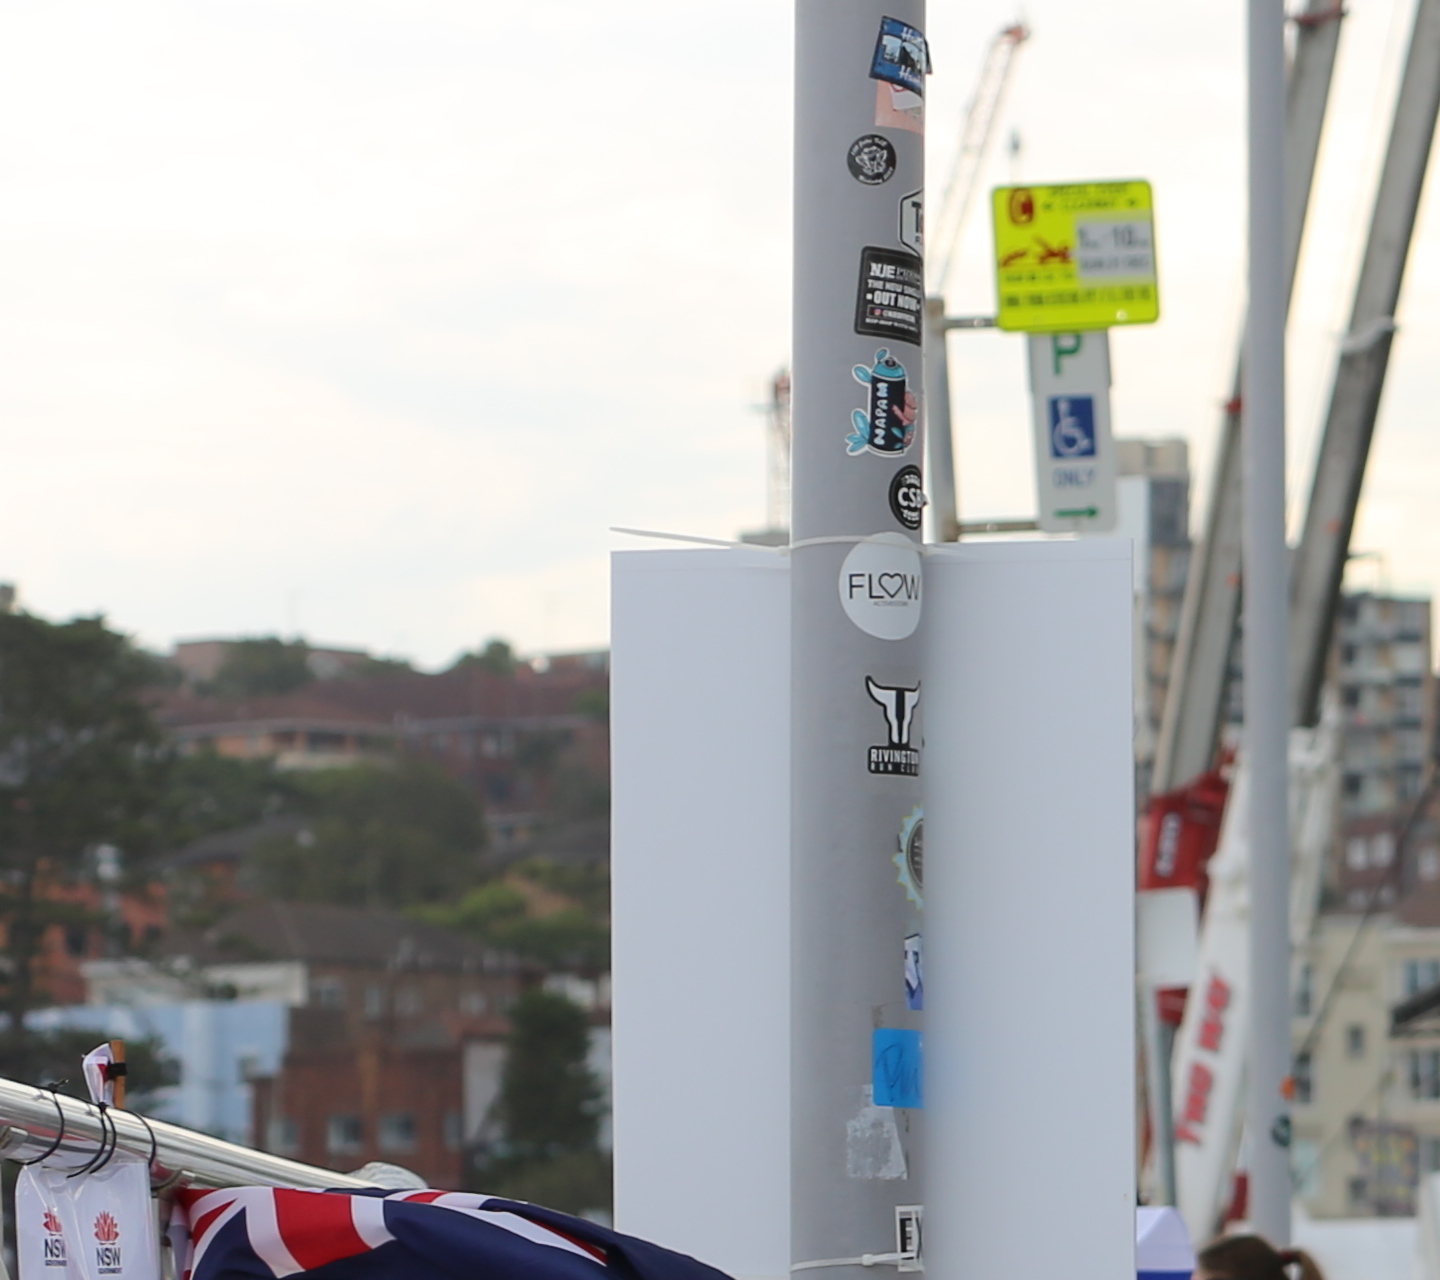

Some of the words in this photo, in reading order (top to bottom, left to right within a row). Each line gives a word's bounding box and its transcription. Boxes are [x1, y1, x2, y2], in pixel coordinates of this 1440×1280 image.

[873, 290, 896, 306] OUT
[874, 382, 889, 446] NAPAM
[1053, 465, 1096, 488] ONLY
[97, 1248, 121, 1267] NSW
